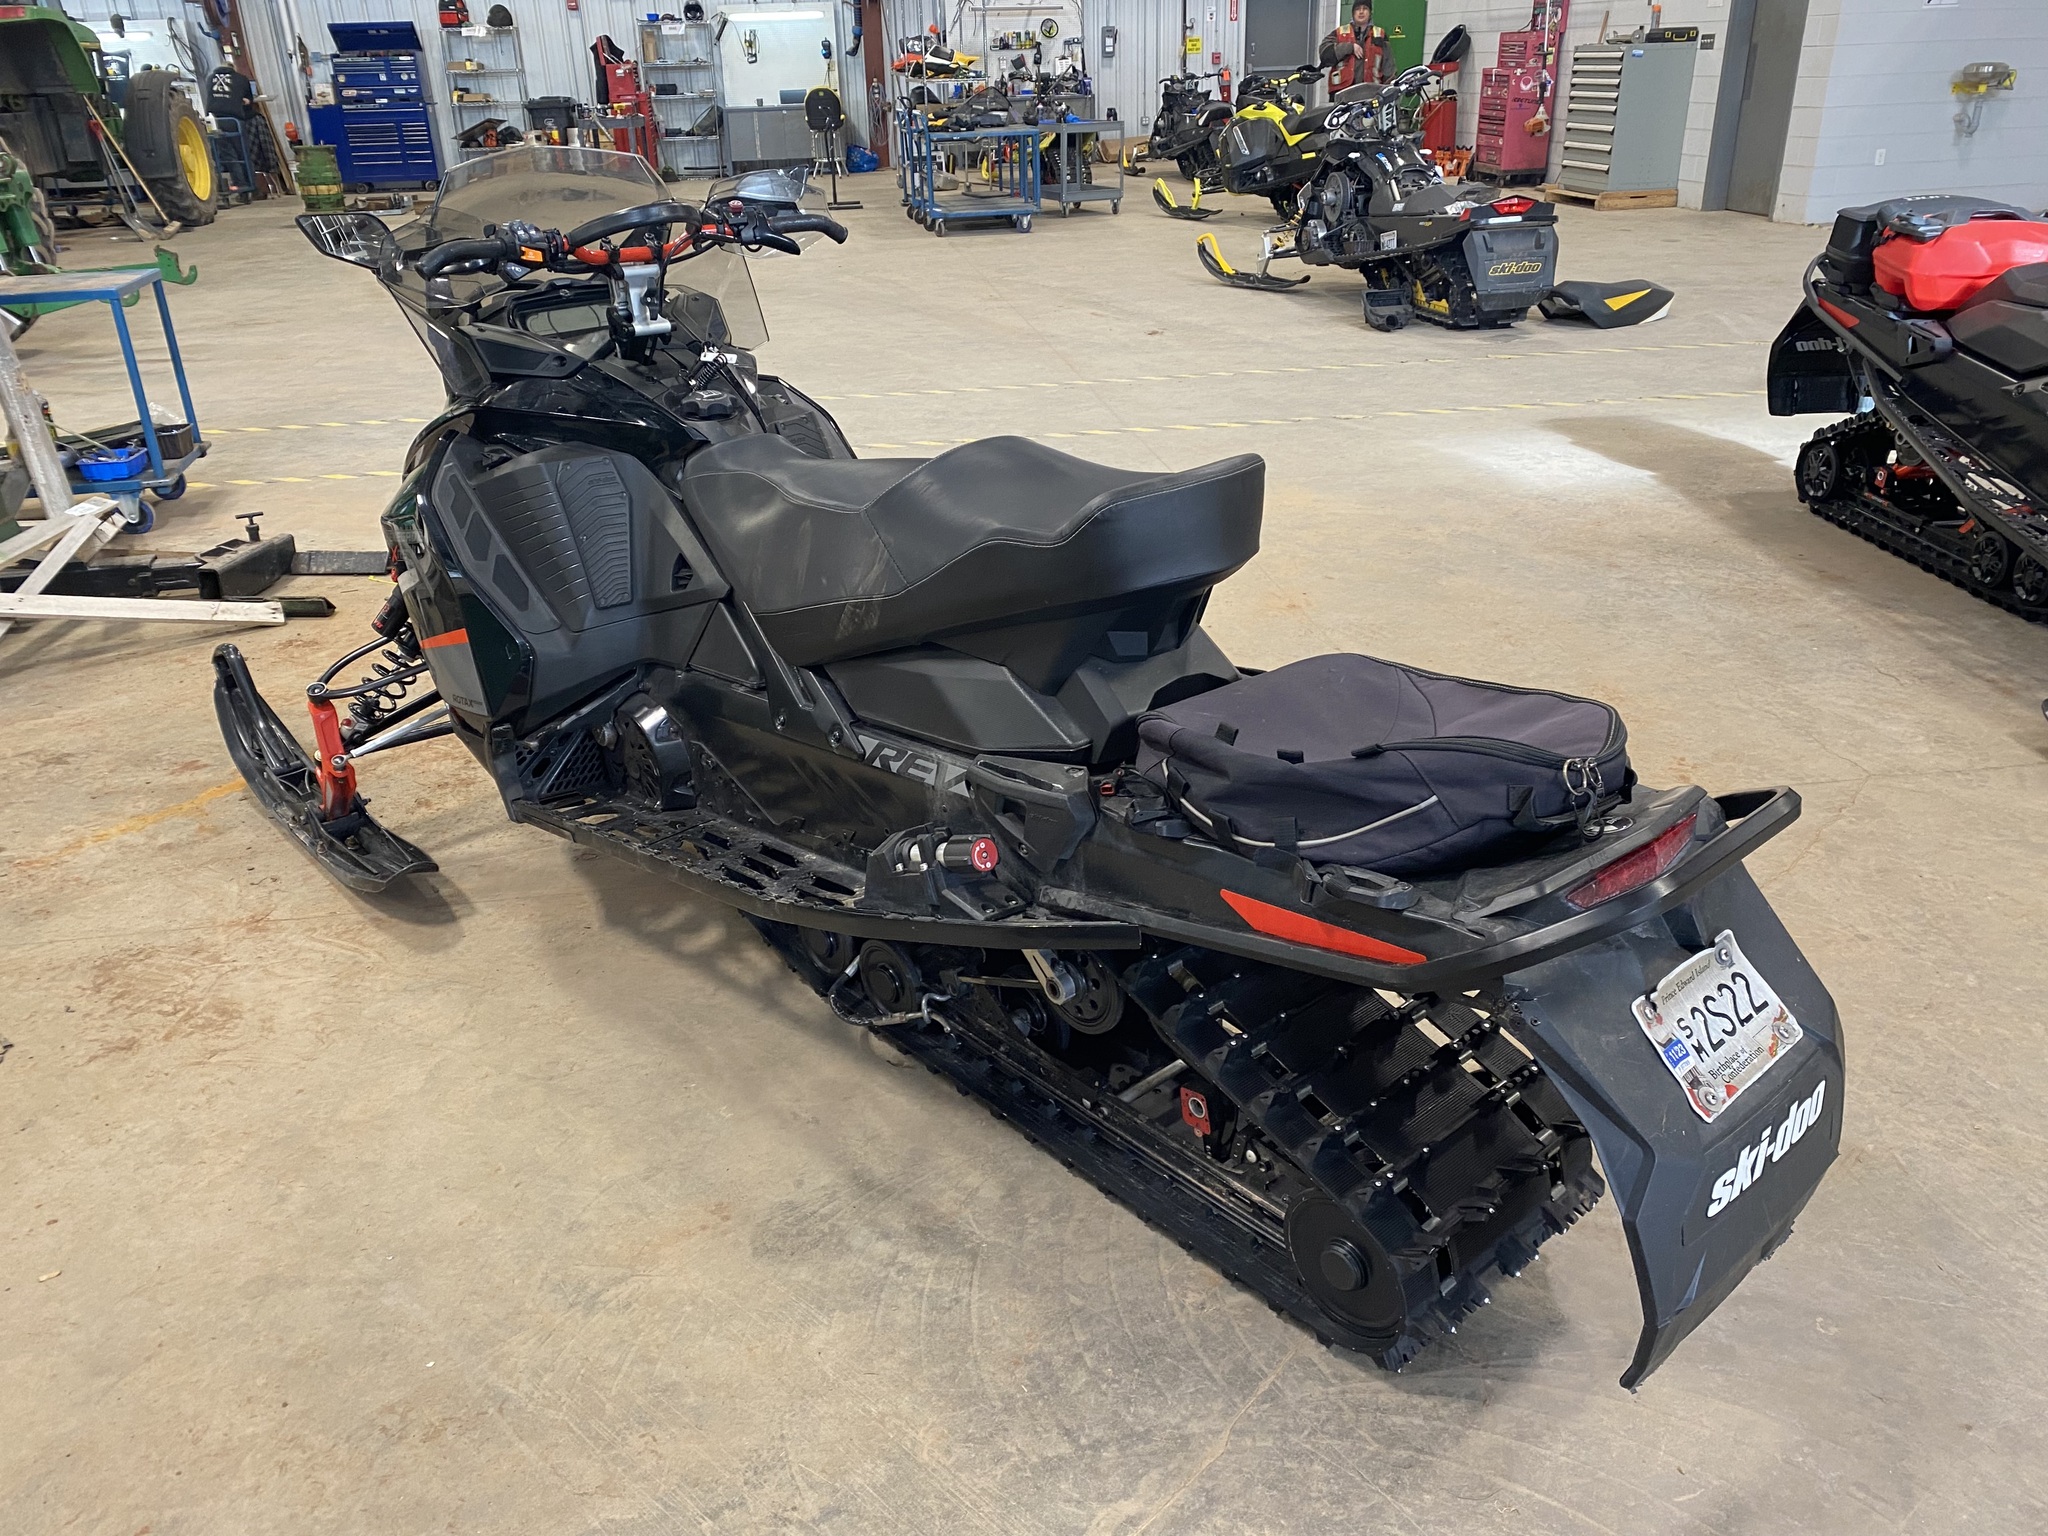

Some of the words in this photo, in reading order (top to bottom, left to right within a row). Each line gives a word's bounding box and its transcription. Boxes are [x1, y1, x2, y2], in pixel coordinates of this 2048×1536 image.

[1489, 261, 1542, 276] ski-doo
[1661, 989, 1677, 1006] Prince
[1676, 971, 1695, 992] Edward
[1695, 959, 1711, 977] Island
[1690, 971, 1770, 1053] 2S22
[1708, 1050, 1741, 1081] Birthplace
[1721, 1045, 1765, 1084] Confederation
[1706, 1079, 1827, 1219] ski-doo
